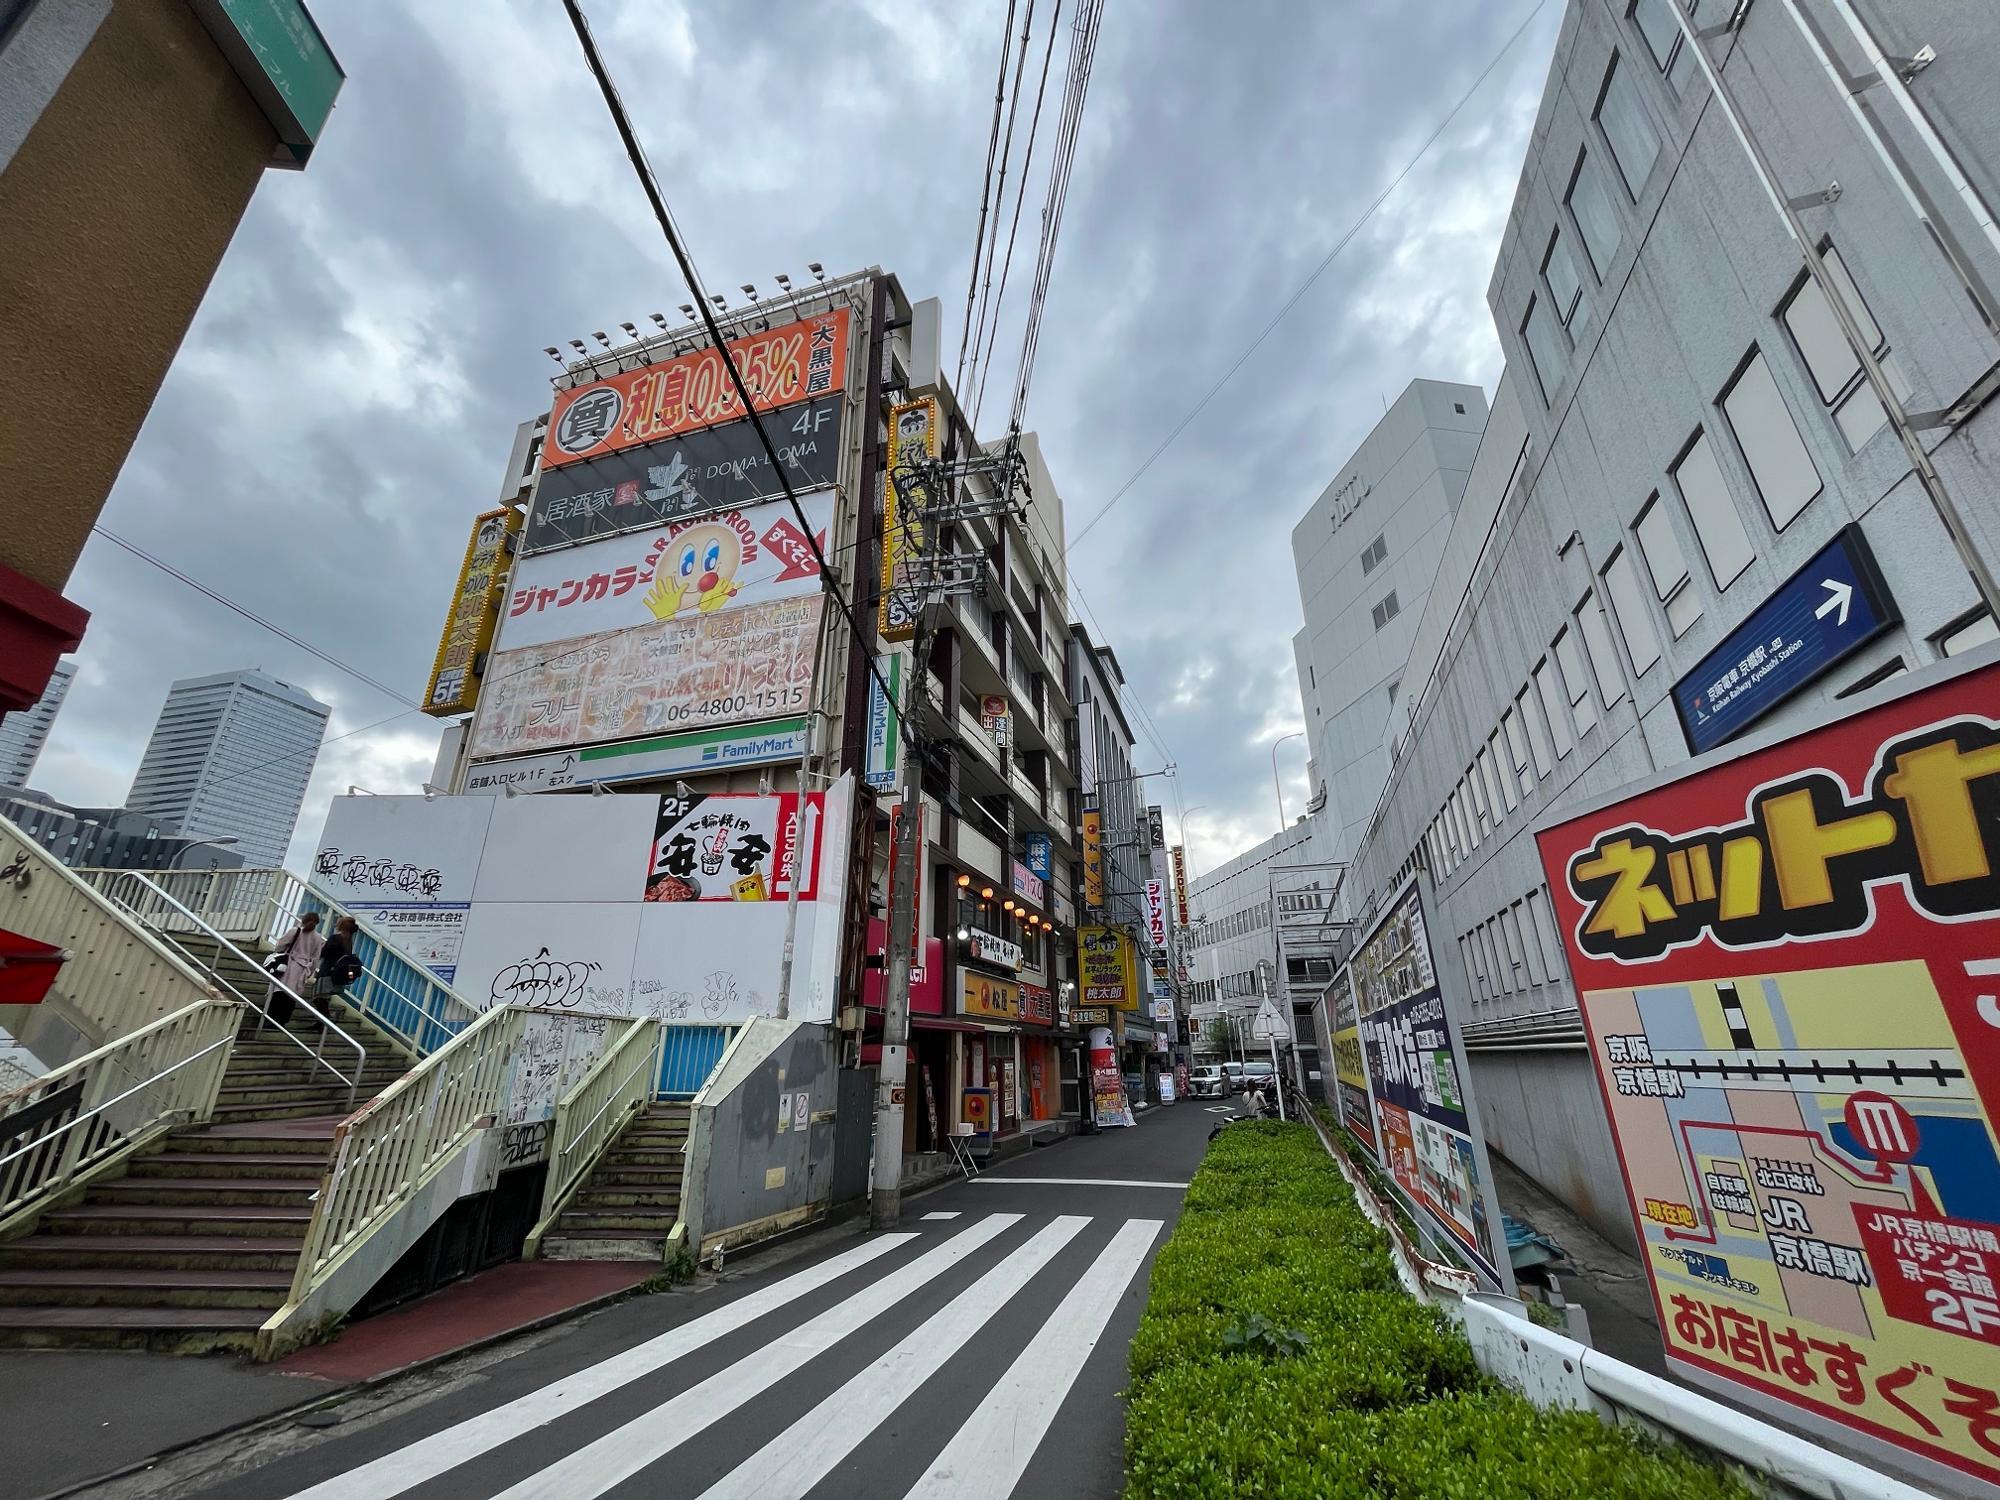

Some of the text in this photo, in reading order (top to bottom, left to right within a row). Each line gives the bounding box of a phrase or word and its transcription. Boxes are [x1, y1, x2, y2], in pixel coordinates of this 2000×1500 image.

[806, 325, 836, 394] 大黒屋
[791, 407, 833, 435] 4F
[544, 488, 615, 524] 居酒家
[726, 511, 758, 565] ROOM
[769, 527, 818, 572] すぐそこ
[510, 566, 638, 617] ジャンカラ
[445, 597, 484, 668] 桃太郎
[1707, 645, 1768, 702] 京阪電車 京橋駅
[1729, 678, 1752, 702] Railway
[1750, 659, 1779, 683] Kyobashi
[1778, 639, 1803, 662] Station
[434, 681, 463, 703] 5F
[667, 688, 803, 722] 06-4800-1515
[723, 737, 793, 759] FamilyMart
[548, 775, 576, 787] 左スグ
[663, 797, 690, 817] 2F
[388, 912, 463, 923] 大京商事株式会社
[1147, 881, 1165, 946] ジャンカラ
[1086, 987, 1122, 1000] 桃太郎
[1605, 1034, 1653, 1064] 京阪
[1613, 1067, 1685, 1099] 京橋駅
[1706, 1172, 1749, 1195] 自転車
[1756, 1168, 1825, 1197] 北口改札
[1645, 1199, 1698, 1228] 現在地
[1711, 1191, 1756, 1216] 駐輪場
[1762, 1197, 1810, 1233] JR
[1770, 1231, 1871, 1287] 京橋駅
[1894, 1238, 1986, 1273] パチンコ
[1900, 1259, 1997, 1299] 京一会館
[1925, 1289, 2000, 1336] 2F
